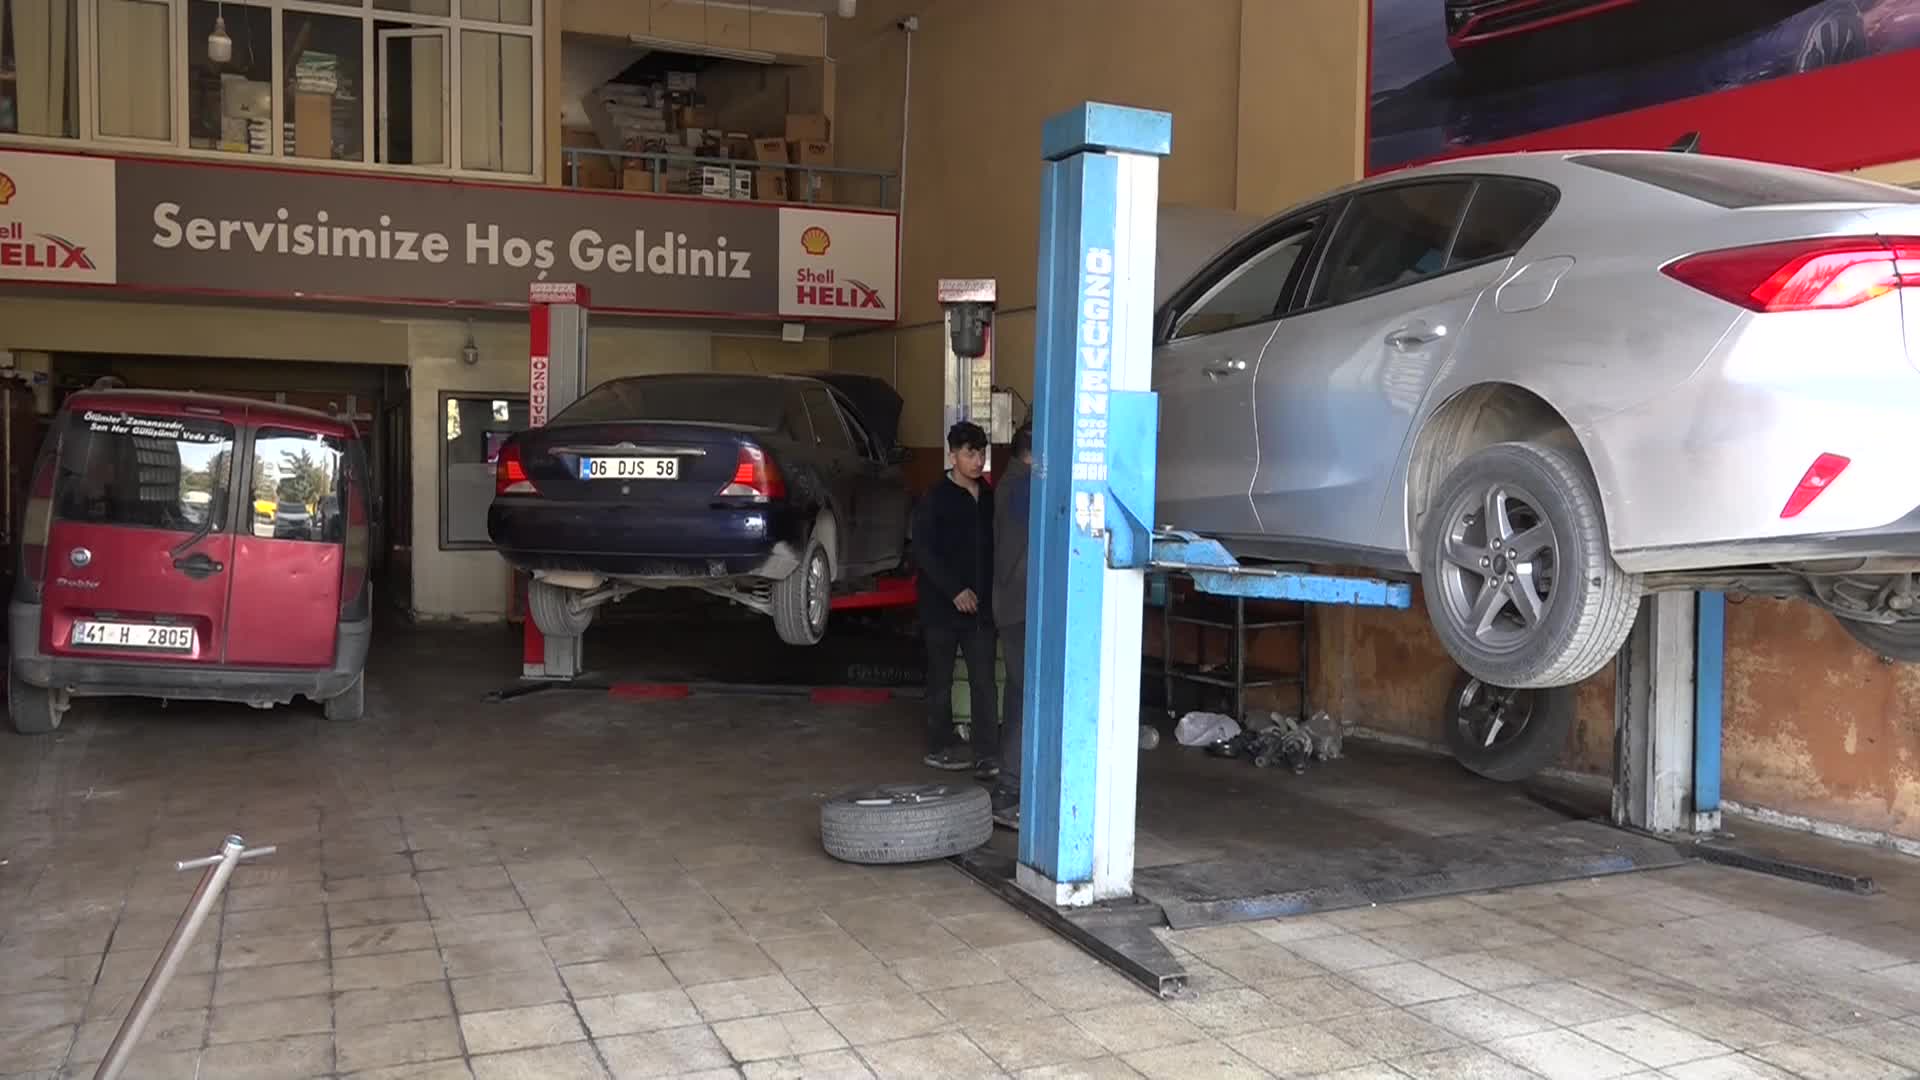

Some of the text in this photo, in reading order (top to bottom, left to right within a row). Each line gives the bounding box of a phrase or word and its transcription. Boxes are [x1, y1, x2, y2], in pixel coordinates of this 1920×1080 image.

[0, 221, 22, 239] ell
[153, 202, 752, 280] Servisimize Hoş Geldiniz
[0, 243, 92, 269] ELIX
[797, 268, 834, 285] Shell
[797, 285, 884, 309] HELIX
[1079, 247, 1112, 415] ÖZGÜVEN
[84, 411, 121, 424] Ölümler
[90, 423, 109, 432] Sen
[182, 431, 205, 442] Veda
[591, 460, 674, 475] 06 DJS 58
[86, 625, 189, 646] 41 H 2805
